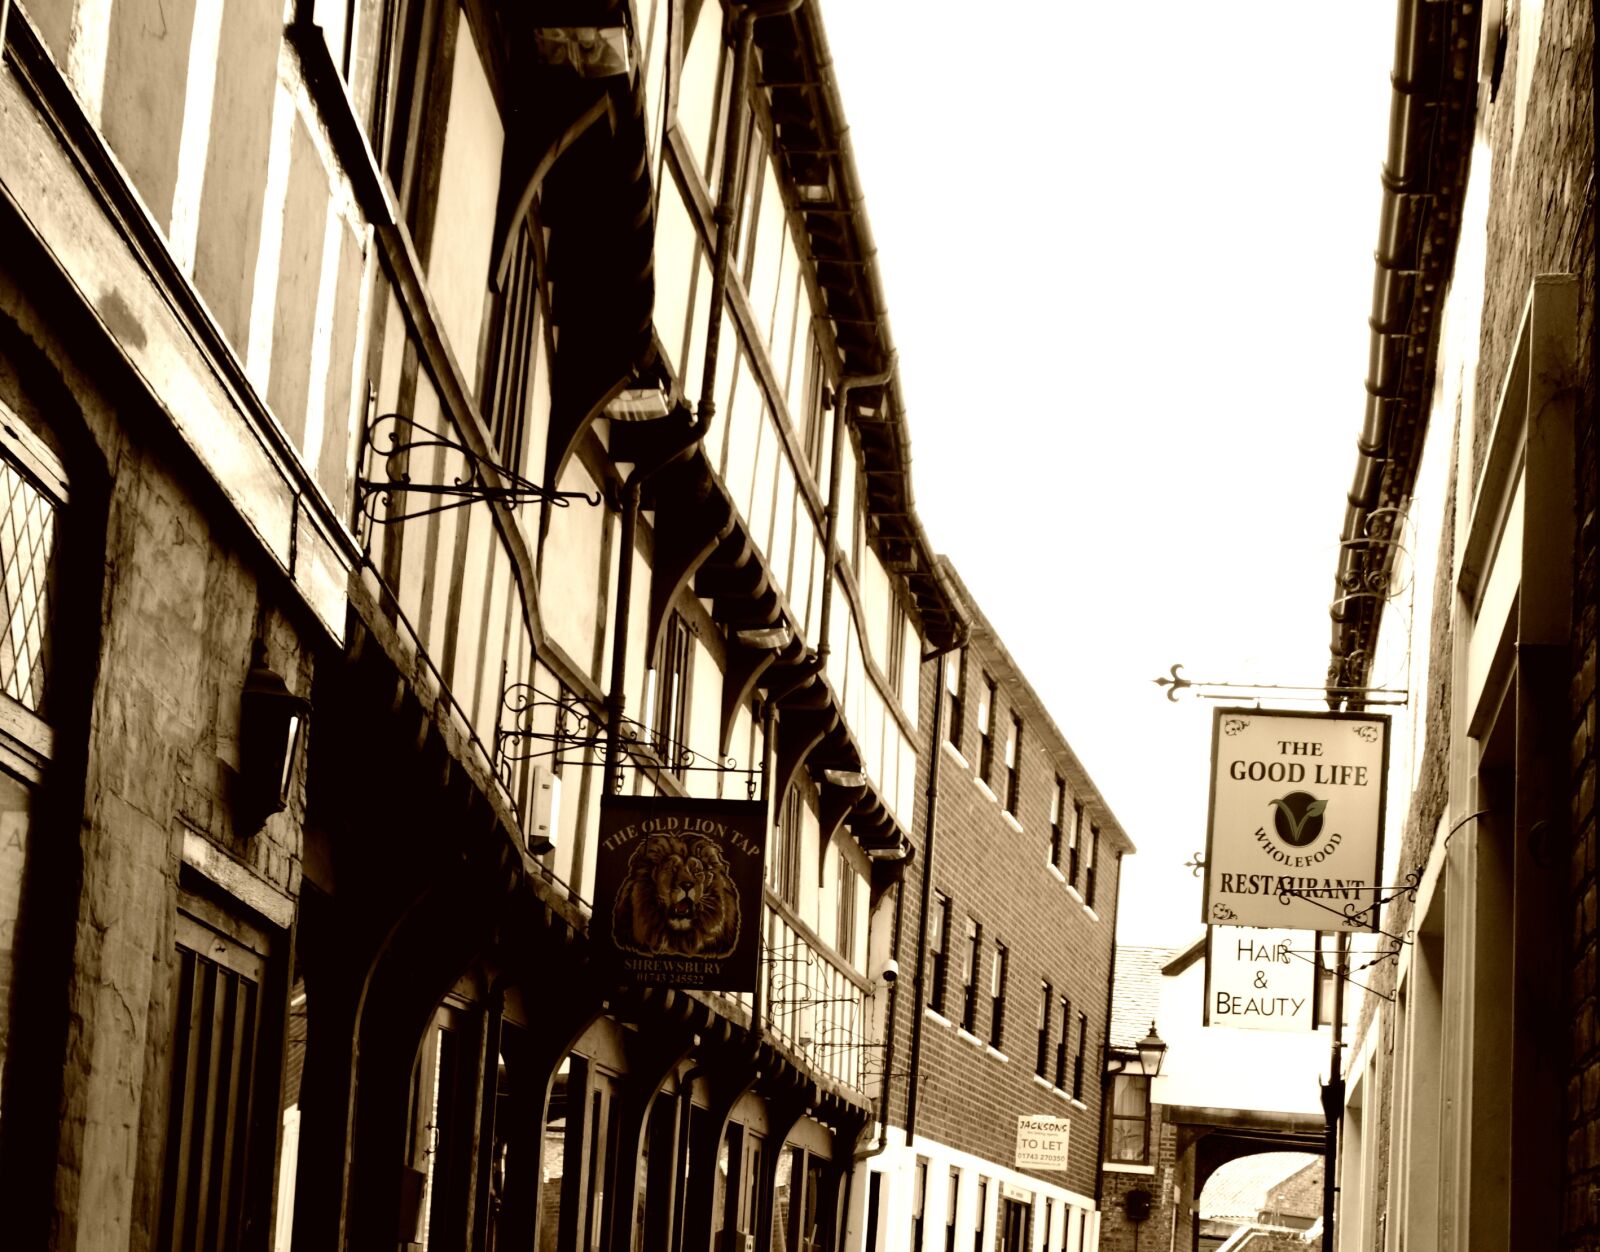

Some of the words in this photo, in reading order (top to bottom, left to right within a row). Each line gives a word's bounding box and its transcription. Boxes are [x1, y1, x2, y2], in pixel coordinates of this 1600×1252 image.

[1277, 740, 1324, 757] THE
[1230, 760, 1306, 783] GOOD
[1314, 764, 1369, 787] LIFE
[601, 824, 639, 852] THE
[641, 816, 680, 834] OLD
[683, 816, 729, 839] LION
[731, 829, 761, 857] TAP
[1254, 826, 1343, 868] WHOLEFOOD
[1220, 872, 1365, 901] RESTAURANT
[1236, 938, 1290, 963] HAIR
[623, 958, 724, 975] SHREWSBURY
[1253, 970, 1268, 989] &
[1216, 991, 1306, 1017] BEAUTY
[1019, 1120, 1068, 1133] JACKSONS
[1021, 1138, 1039, 1150] TO
[1042, 1140, 1064, 1151] LET
